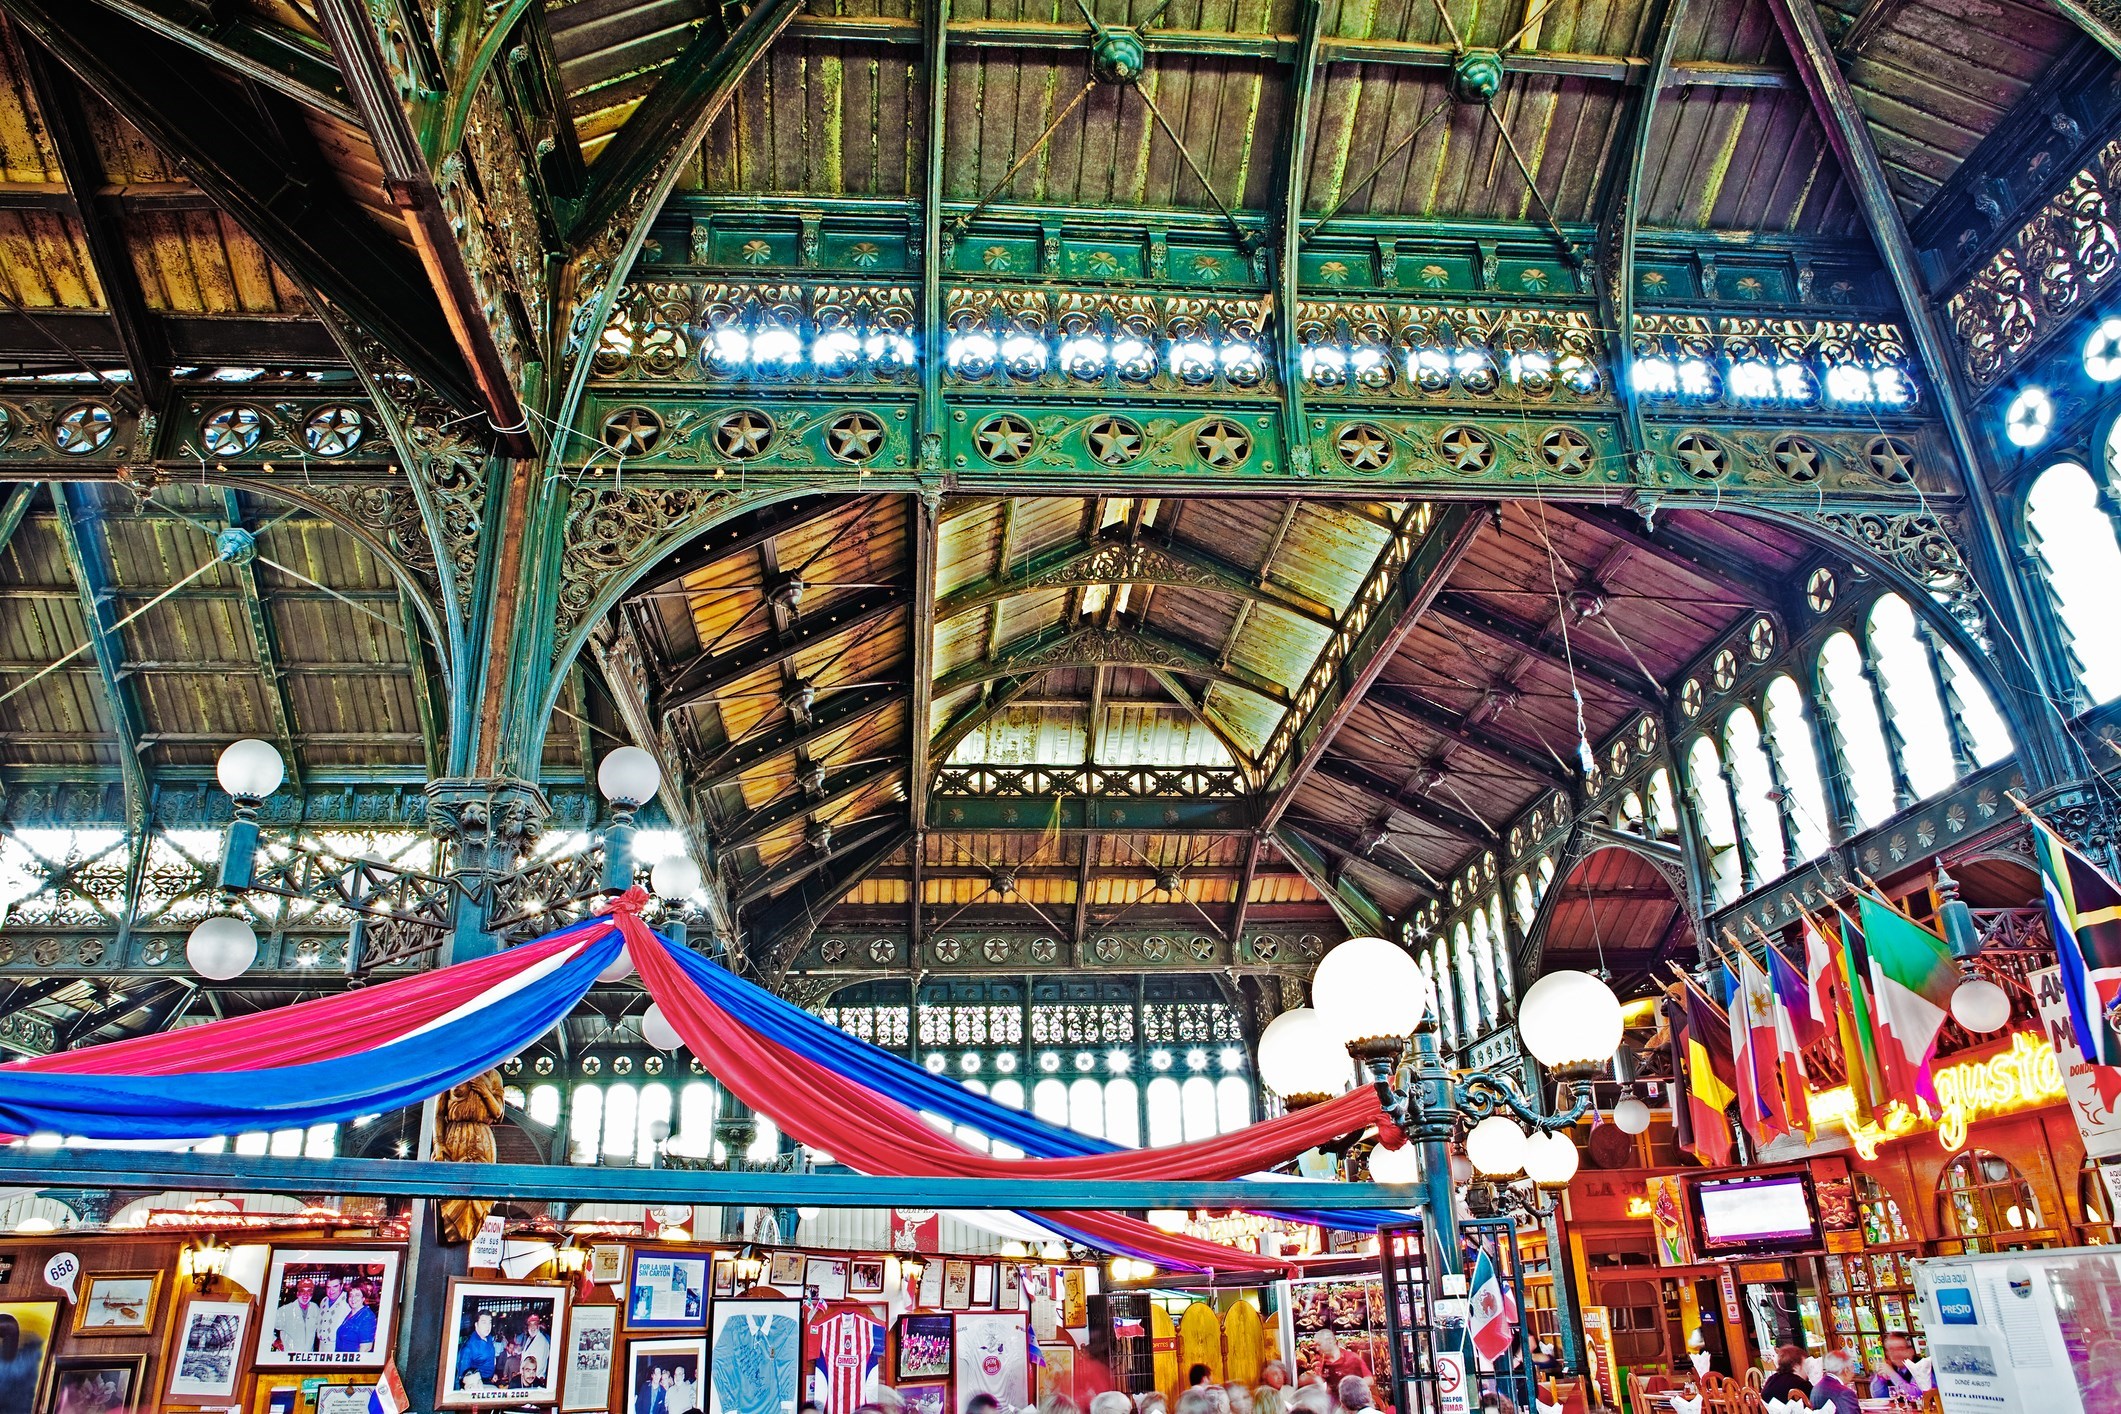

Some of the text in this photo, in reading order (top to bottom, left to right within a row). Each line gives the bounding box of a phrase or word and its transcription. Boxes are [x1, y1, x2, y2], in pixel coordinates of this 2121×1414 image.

[1585, 1182, 1615, 1197] LA
[50, 1259, 74, 1281] 658
[287, 1352, 361, 1363] TELETON 2002
[1971, 1380, 1991, 1388] AUGUSTO
[1968, 1394, 2005, 1402] ANIVERSARIO
